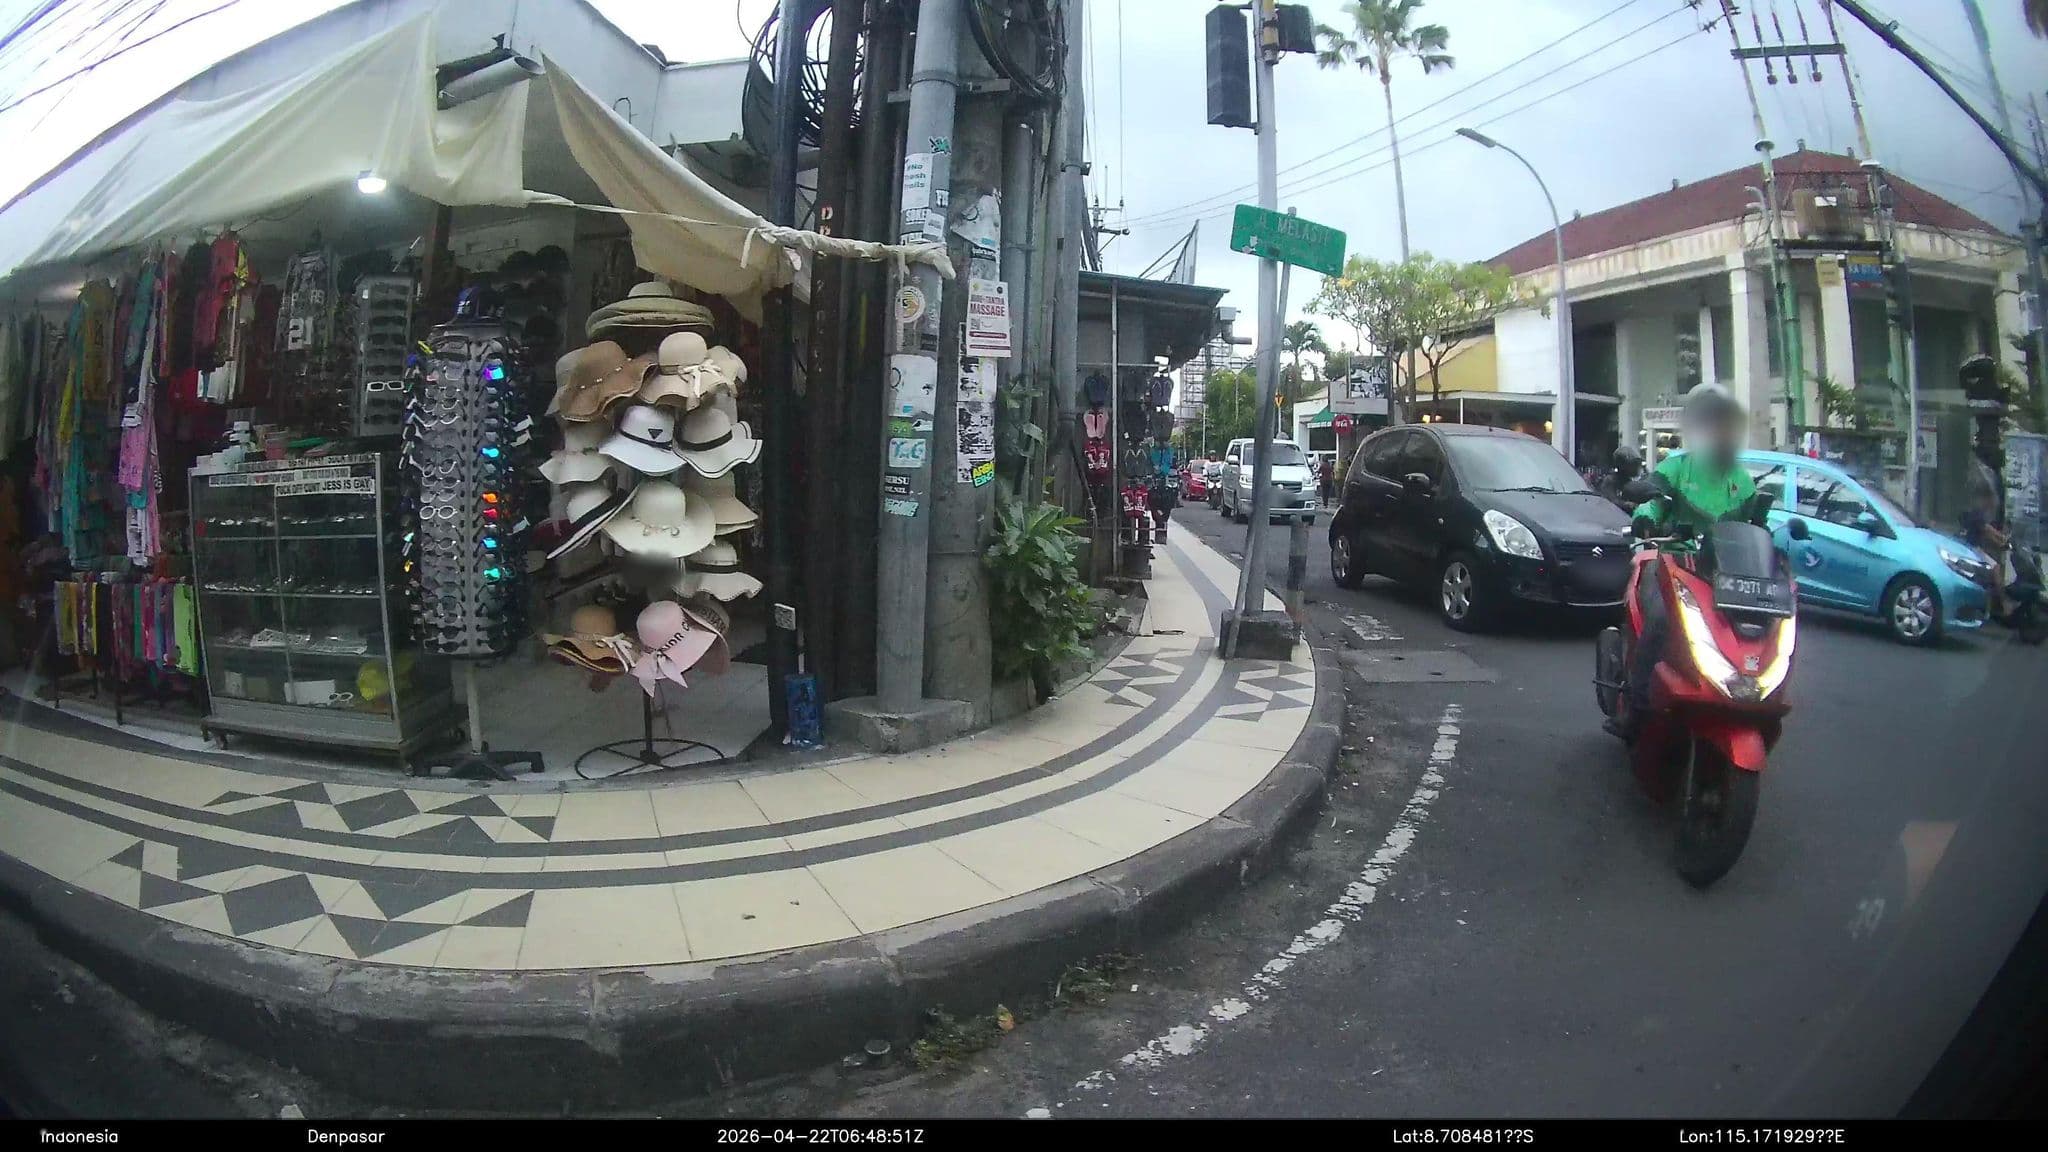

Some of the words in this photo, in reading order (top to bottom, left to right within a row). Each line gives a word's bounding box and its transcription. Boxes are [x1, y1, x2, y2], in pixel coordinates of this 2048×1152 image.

[970, 303, 1006, 317] MASSAGE
[322, 479, 342, 491] JESS
[343, 479, 352, 490] IS
